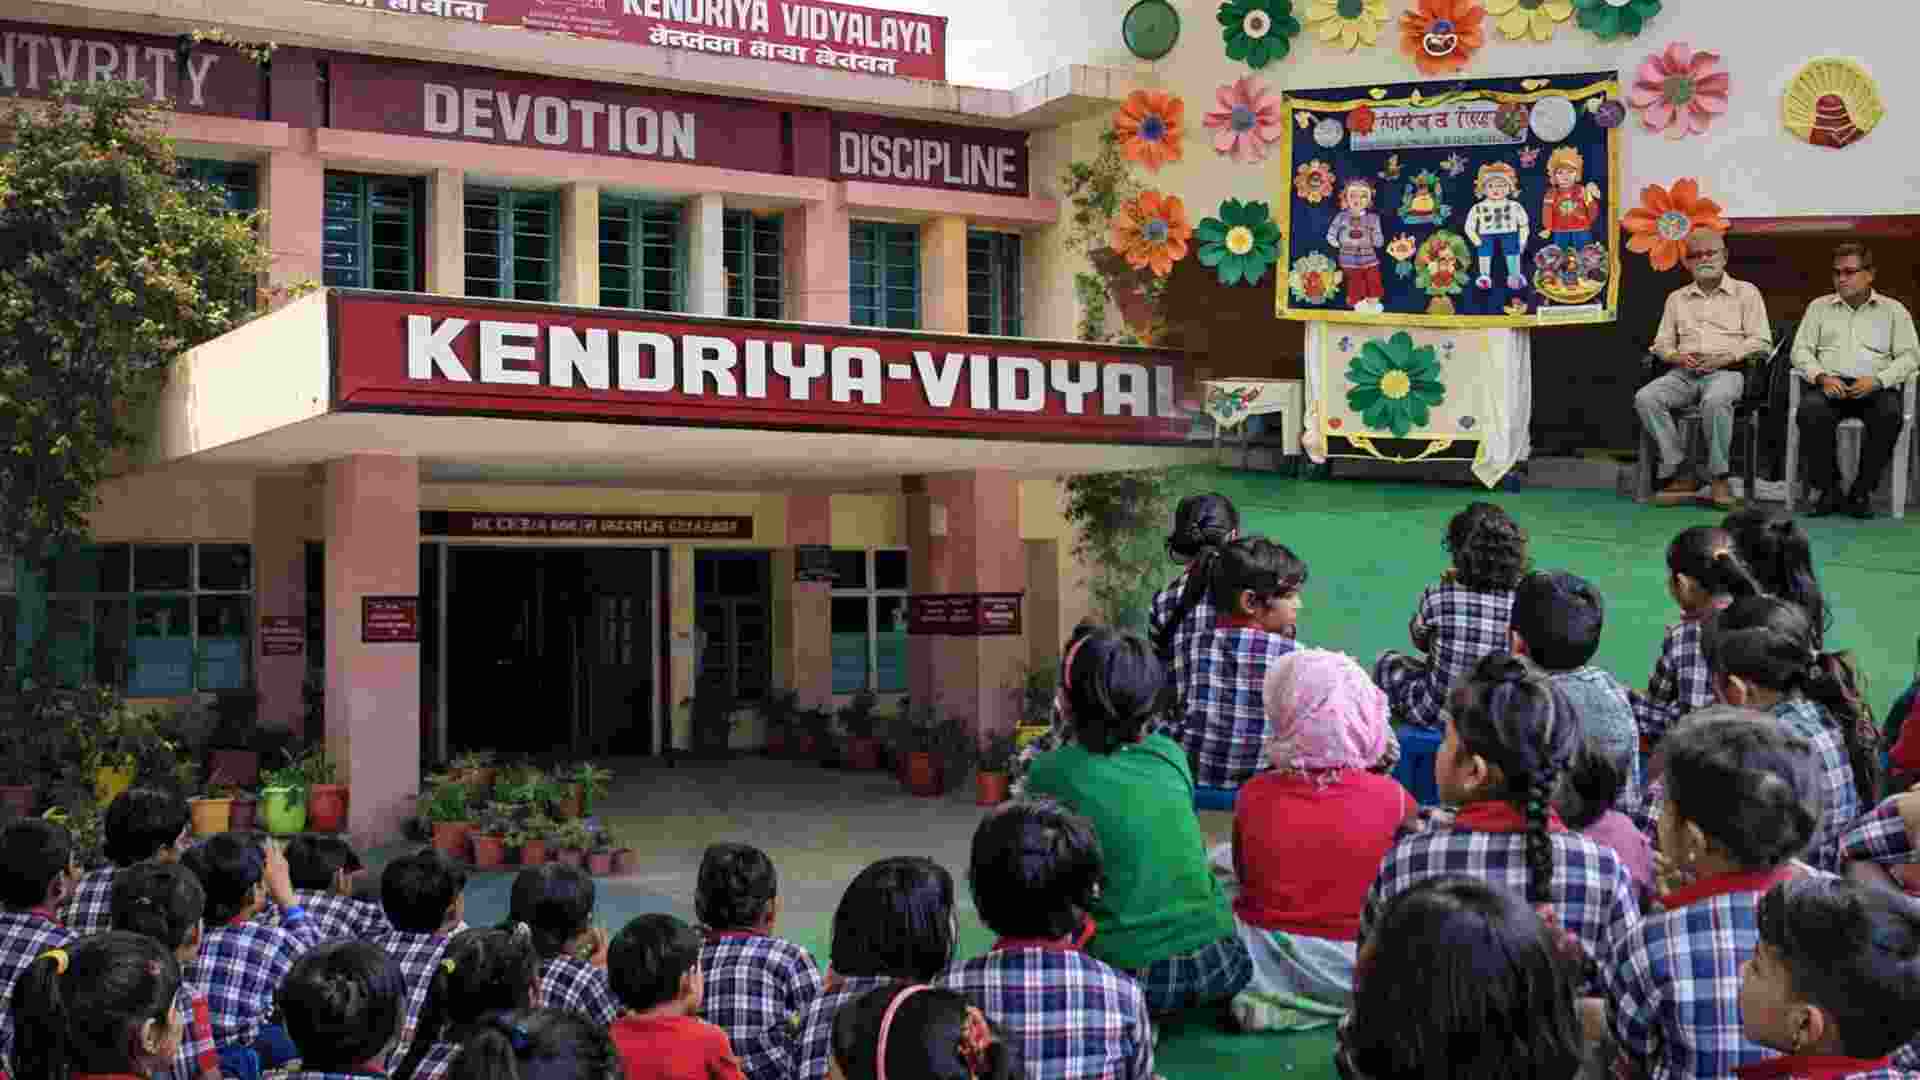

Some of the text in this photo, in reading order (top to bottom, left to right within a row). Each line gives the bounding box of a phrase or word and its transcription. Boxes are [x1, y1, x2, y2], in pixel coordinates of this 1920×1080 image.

[781, 3, 932, 54] VIDYALAYA
[423, 83, 695, 160] DEVOTION
[839, 131, 1016, 189] DISCIPLINE
